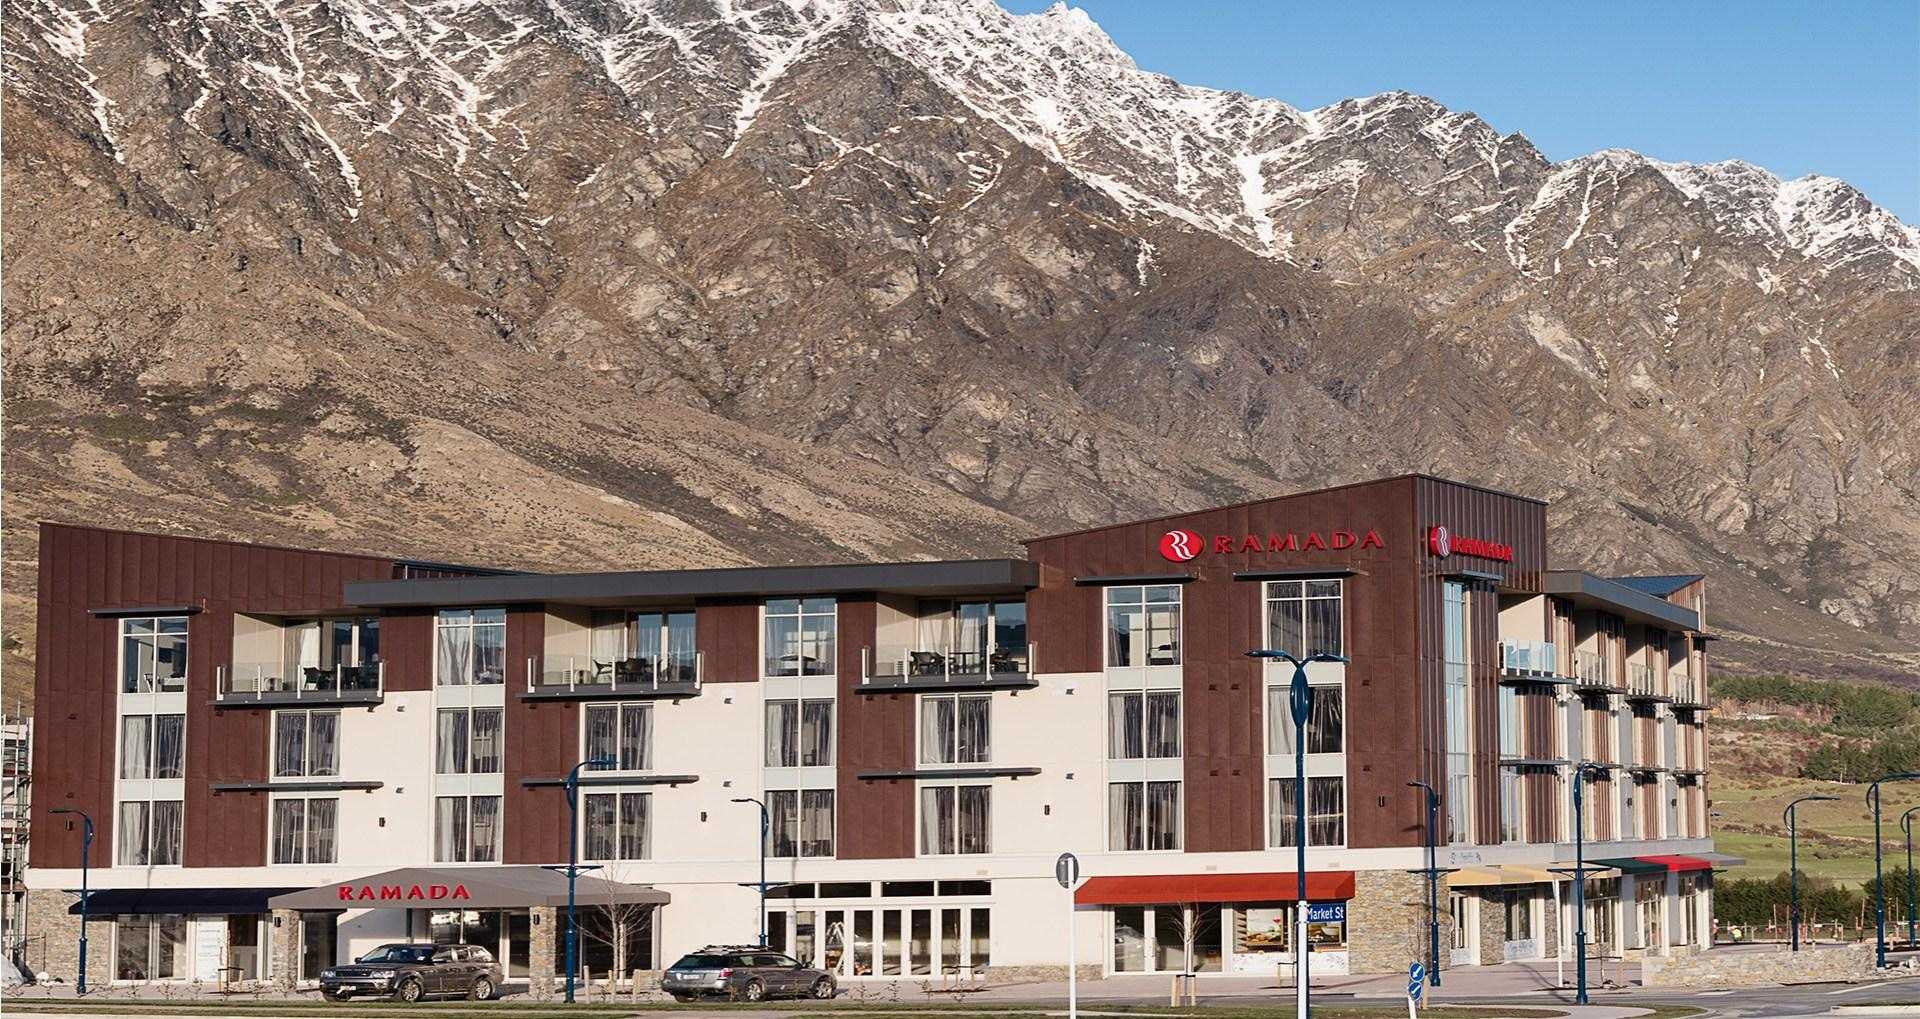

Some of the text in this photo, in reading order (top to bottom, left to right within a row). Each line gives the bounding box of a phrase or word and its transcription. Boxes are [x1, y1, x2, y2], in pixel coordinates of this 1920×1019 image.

[1213, 529, 1384, 554] RAMADA
[338, 884, 470, 901] RAMADA
[1335, 906, 1344, 919] St
